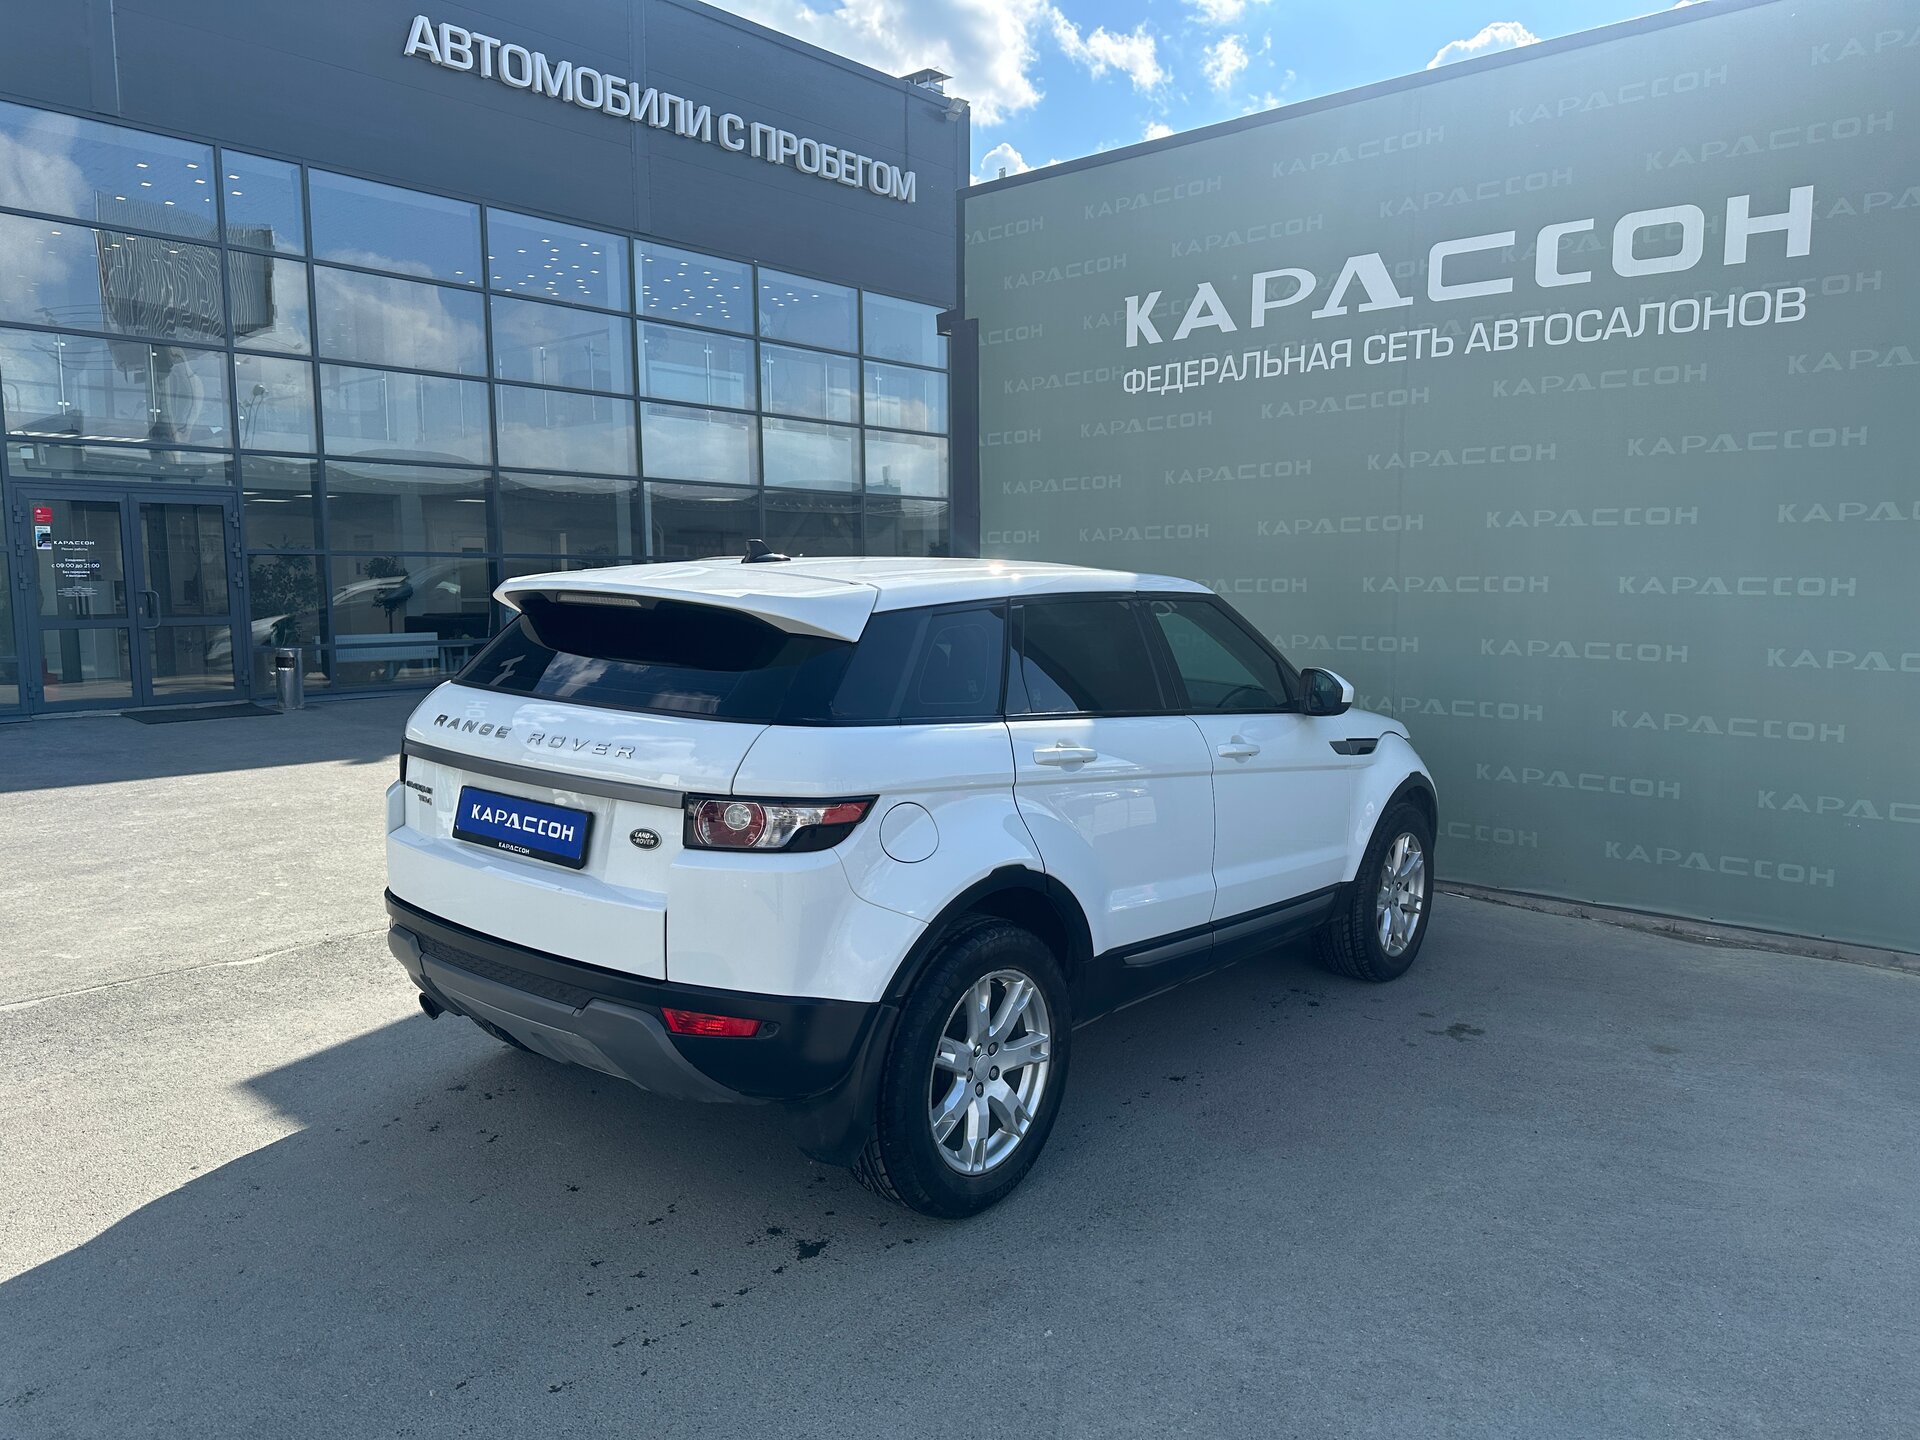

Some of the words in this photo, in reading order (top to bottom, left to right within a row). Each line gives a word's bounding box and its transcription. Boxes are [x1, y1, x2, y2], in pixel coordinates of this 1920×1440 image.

[404, 15, 711, 142] АВТОМОБИЛИ
[718, 113, 744, 151] С
[750, 121, 916, 203] ПРОБЕГОМ
[1122, 338, 1353, 396] ФЕДЕРАЛЬНАЯ
[1362, 327, 1455, 366] СЕТЬ
[1464, 286, 1808, 355] АВТОСАЛОНОВ
[434, 713, 512, 740] RANGE
[526, 732, 636, 760] ROVER
